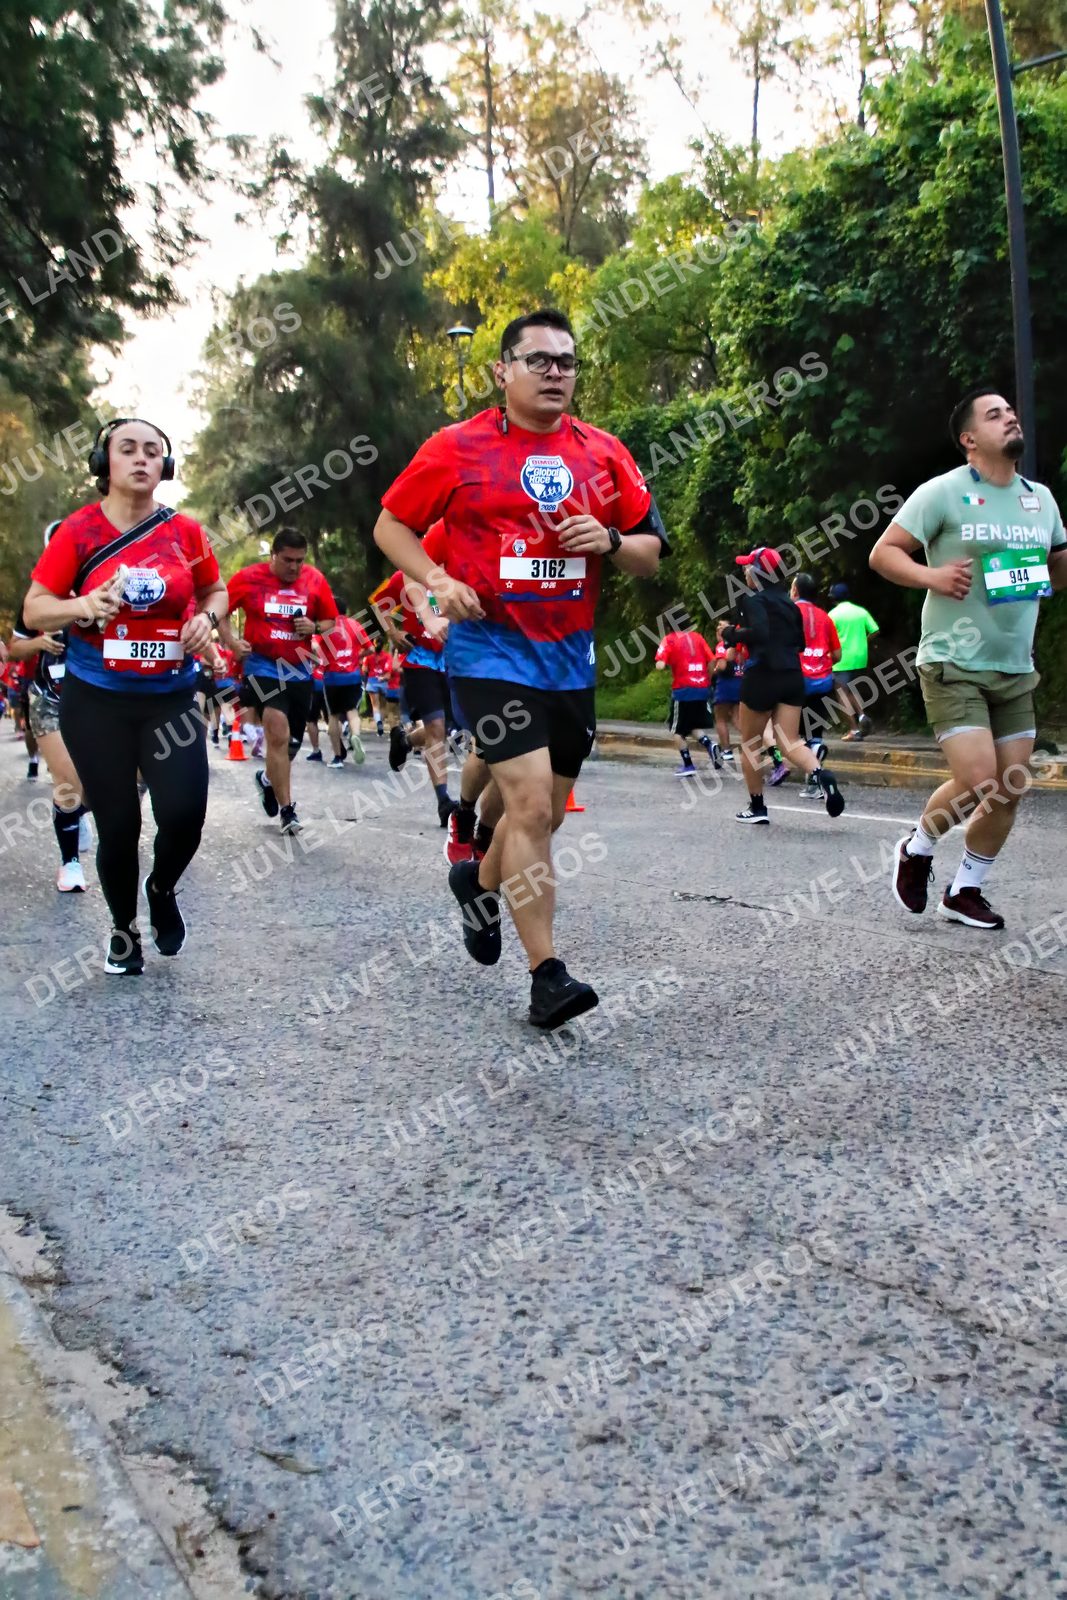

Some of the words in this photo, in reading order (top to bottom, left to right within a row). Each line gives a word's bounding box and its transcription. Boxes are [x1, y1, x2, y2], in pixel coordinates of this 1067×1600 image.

[533, 467, 560, 477] Global
[529, 476, 550, 484] Race
[531, 559, 566, 578] 3162
[1009, 568, 1030, 584] 944
[130, 642, 166, 659] 3623
[803, 647, 824, 657] 20-26
